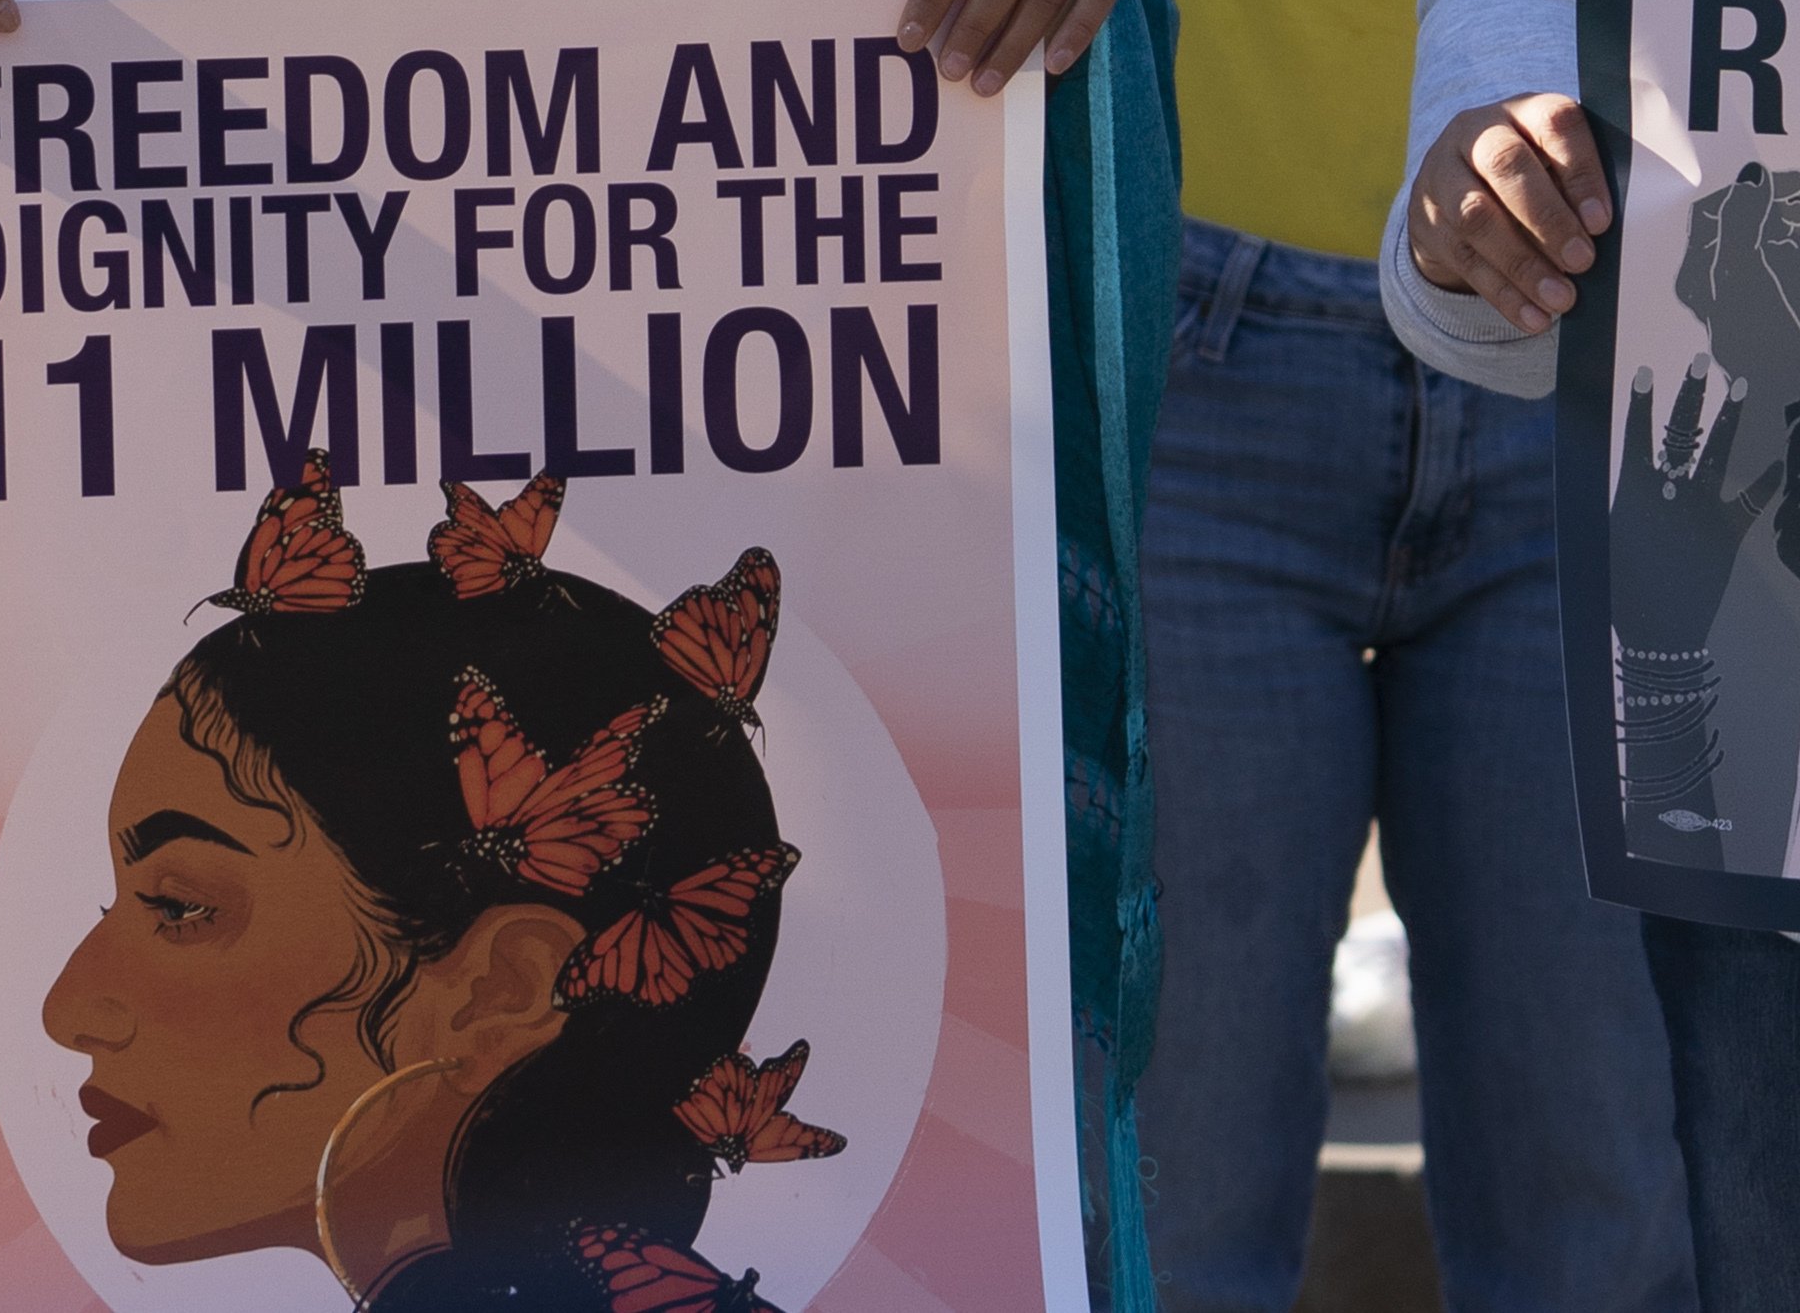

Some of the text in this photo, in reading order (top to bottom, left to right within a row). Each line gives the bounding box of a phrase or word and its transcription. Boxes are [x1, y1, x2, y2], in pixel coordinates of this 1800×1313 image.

[645, 37, 941, 171] AND
[455, 183, 680, 296] FOR
[719, 174, 944, 285] THE
[212, 304, 944, 495] MILLION
